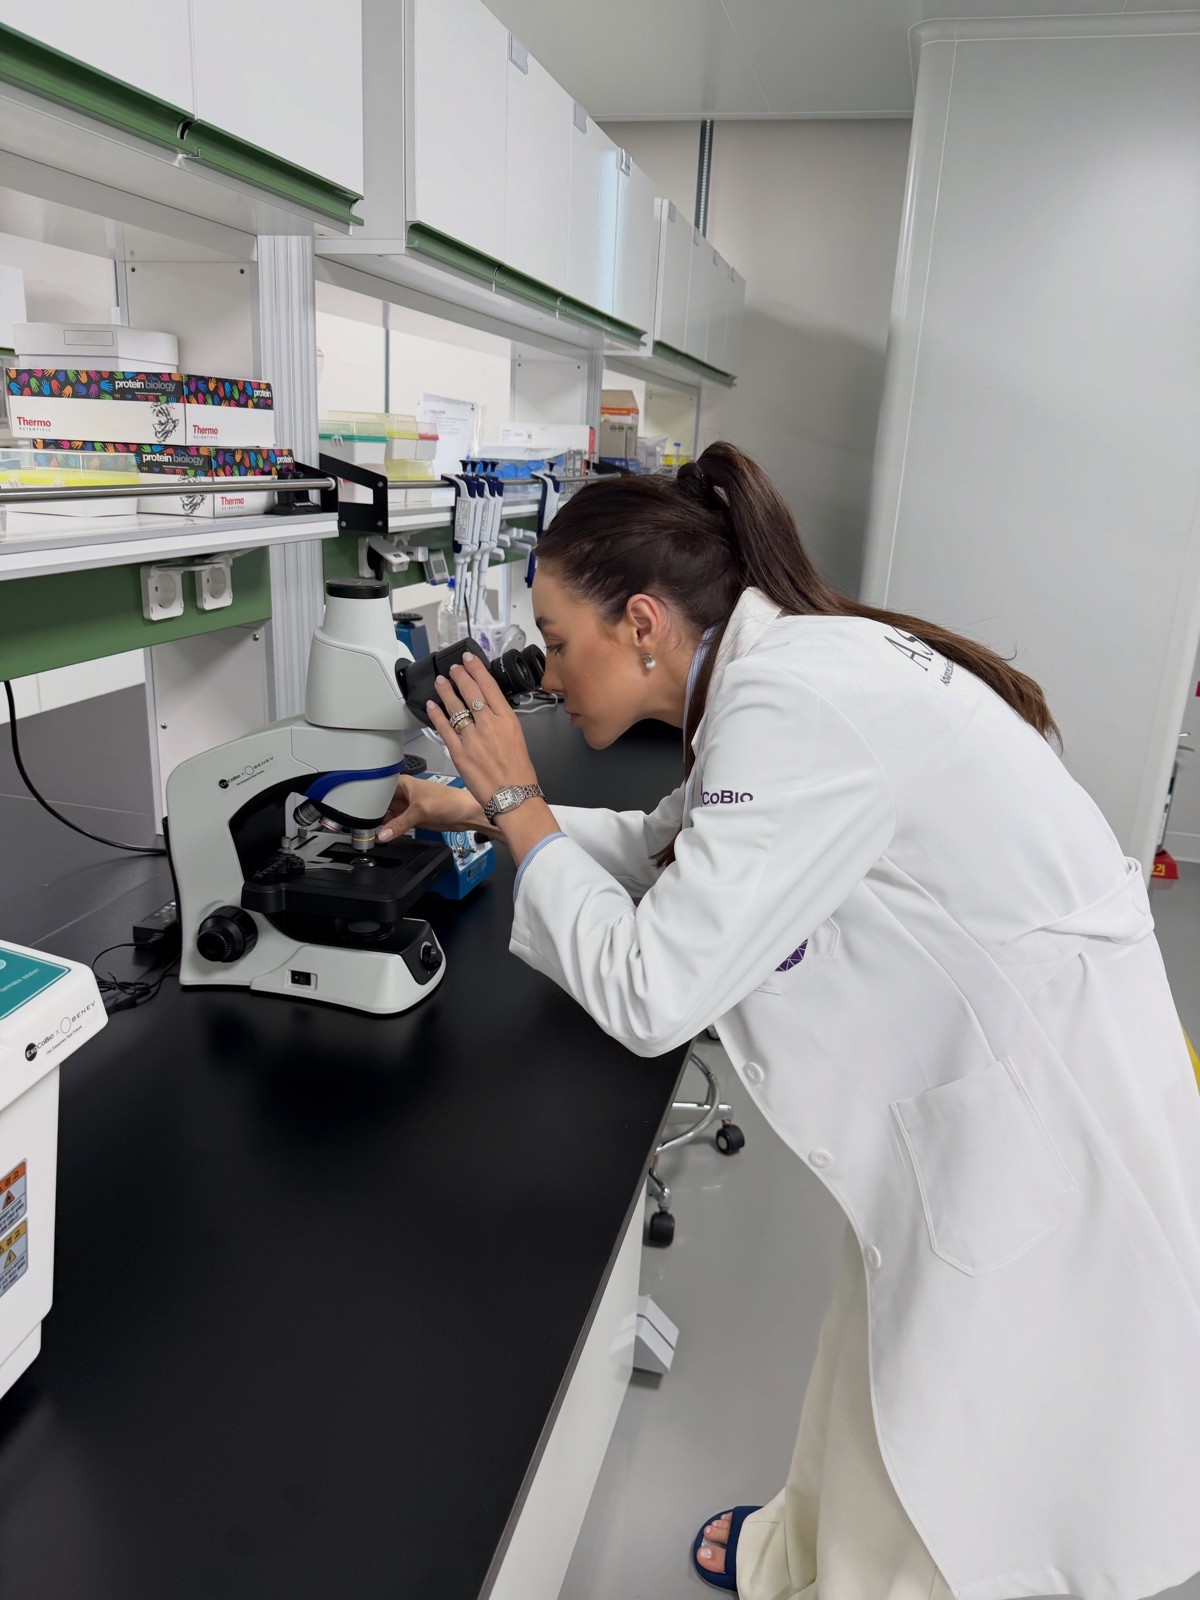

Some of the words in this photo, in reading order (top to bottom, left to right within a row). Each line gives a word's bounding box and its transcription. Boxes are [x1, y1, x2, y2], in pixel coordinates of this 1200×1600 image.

[115, 379, 144, 390] protein
[145, 380, 176, 392] biology
[253, 388, 272, 398] protein
[16, 416, 51, 427] Thermo
[192, 424, 218, 435] Thermo
[142, 452, 172, 463] protein
[173, 453, 204, 465] biology
[276, 455, 294, 464] protein
[220, 496, 245, 506] Thermo
[254, 756, 274, 769] BENEV
[72, 1000, 96, 1022] BENEV
